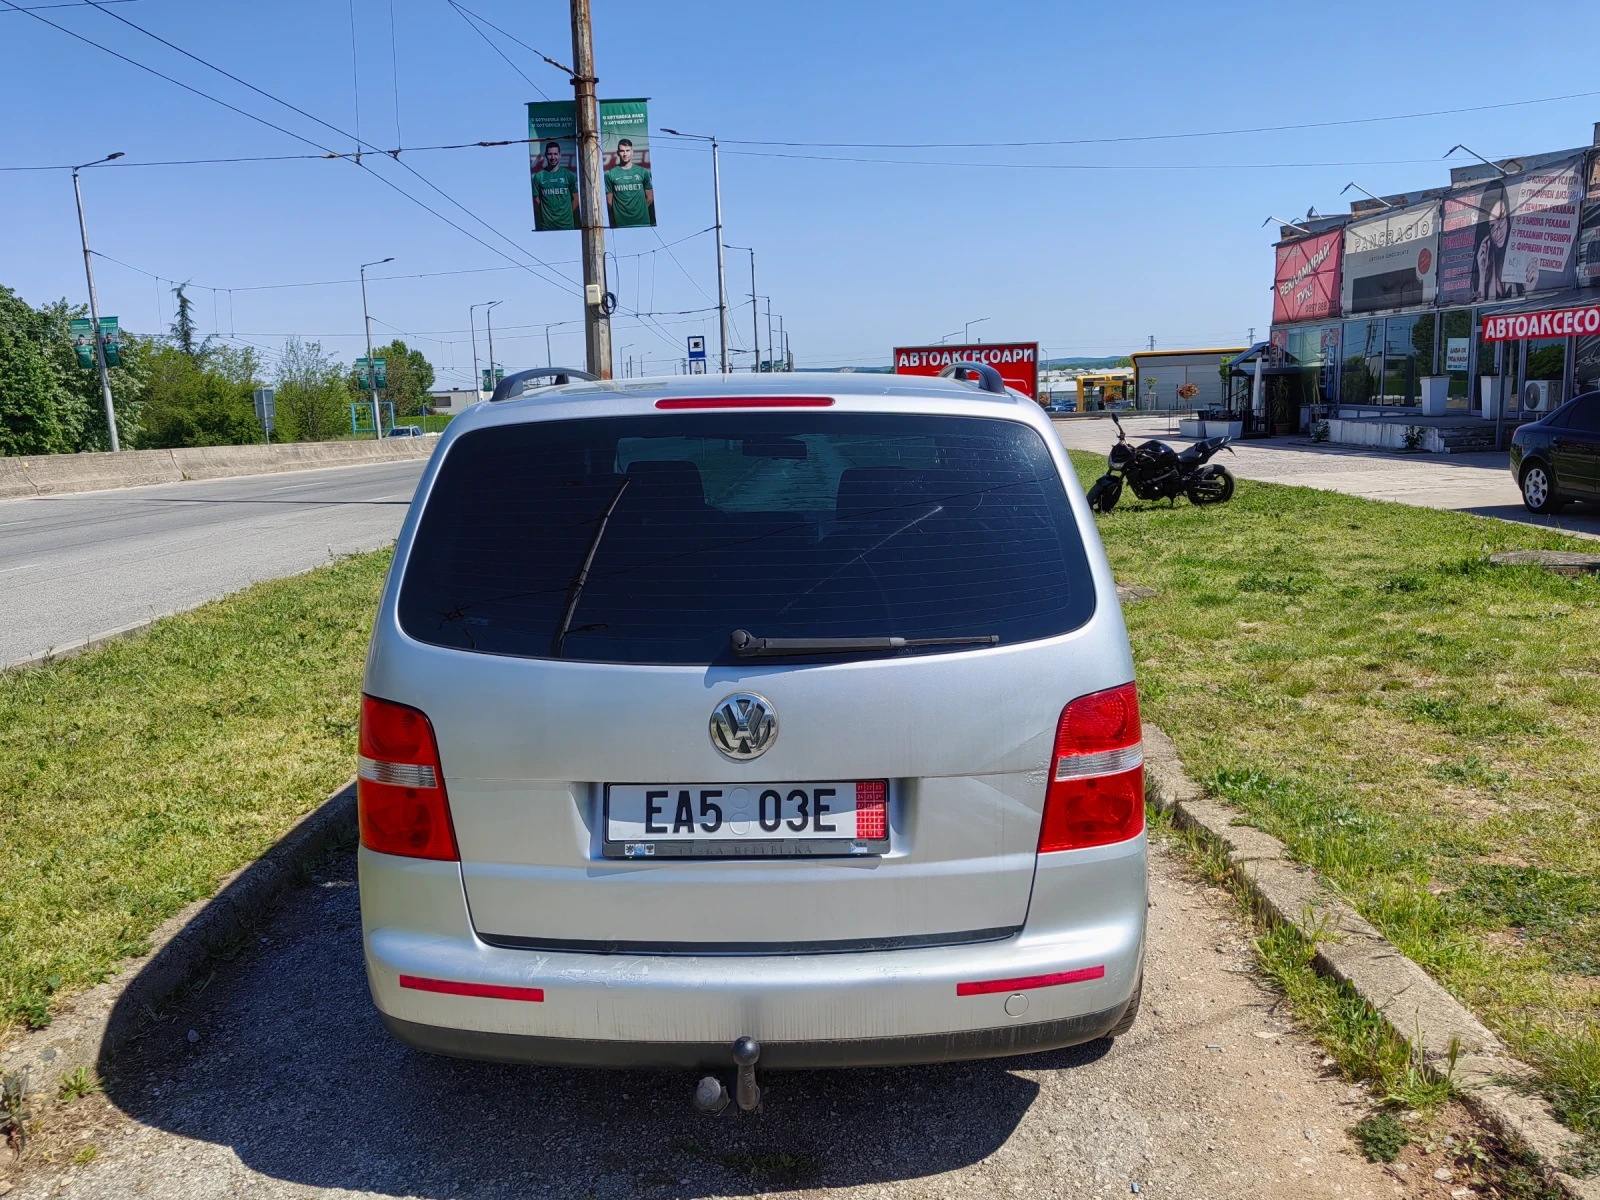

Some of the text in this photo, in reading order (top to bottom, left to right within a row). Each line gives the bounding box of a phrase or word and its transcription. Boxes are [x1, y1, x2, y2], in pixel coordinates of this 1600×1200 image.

[541, 187, 569, 195] WINBET
[614, 183, 642, 192] WINBET
[1355, 220, 1430, 252] PANCRACIO
[1385, 249, 1410, 259] CHOCOLATE
[1280, 240, 1330, 298] РЕКЛАМИРАЙ
[1540, 258, 1563, 270] ТЕНИСКИ
[1485, 309, 1600, 339] АВТОАКСЕСО
[899, 348, 1034, 367] АВТОАКСЕСОАРИ
[645, 788, 837, 834] EA5 03E
